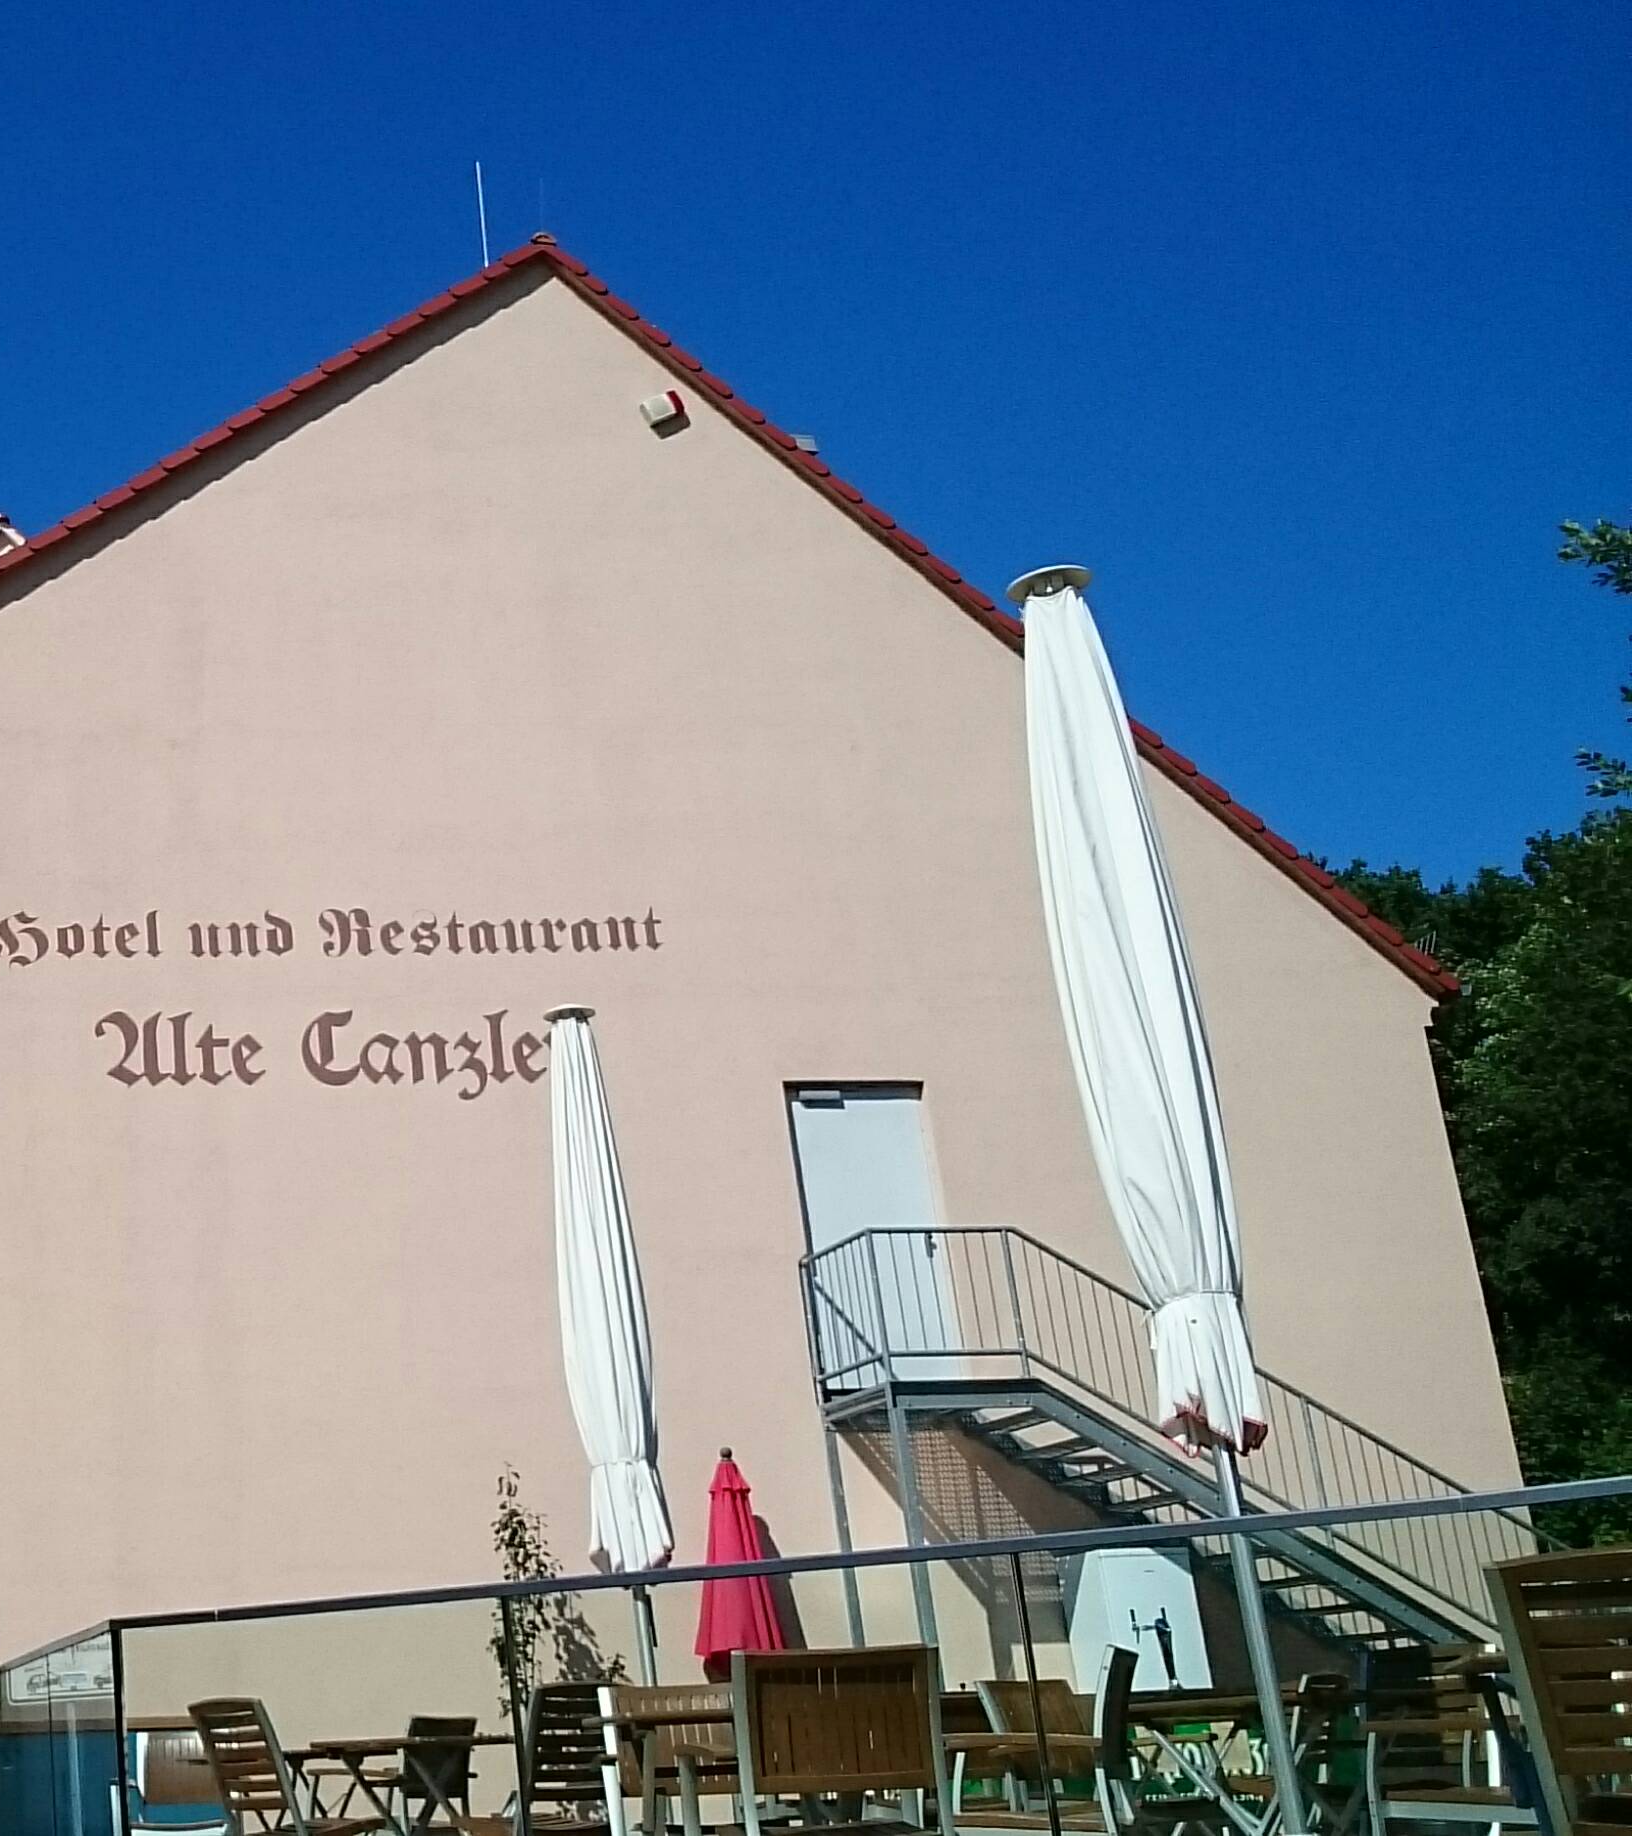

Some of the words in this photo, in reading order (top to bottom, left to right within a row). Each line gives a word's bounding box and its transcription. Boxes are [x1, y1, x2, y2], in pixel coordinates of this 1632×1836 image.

[187, 909, 295, 959] und
[318, 906, 665, 959] Restaurant
[94, 1011, 266, 1088] Alte
[301, 1009, 552, 1101] Canzle
